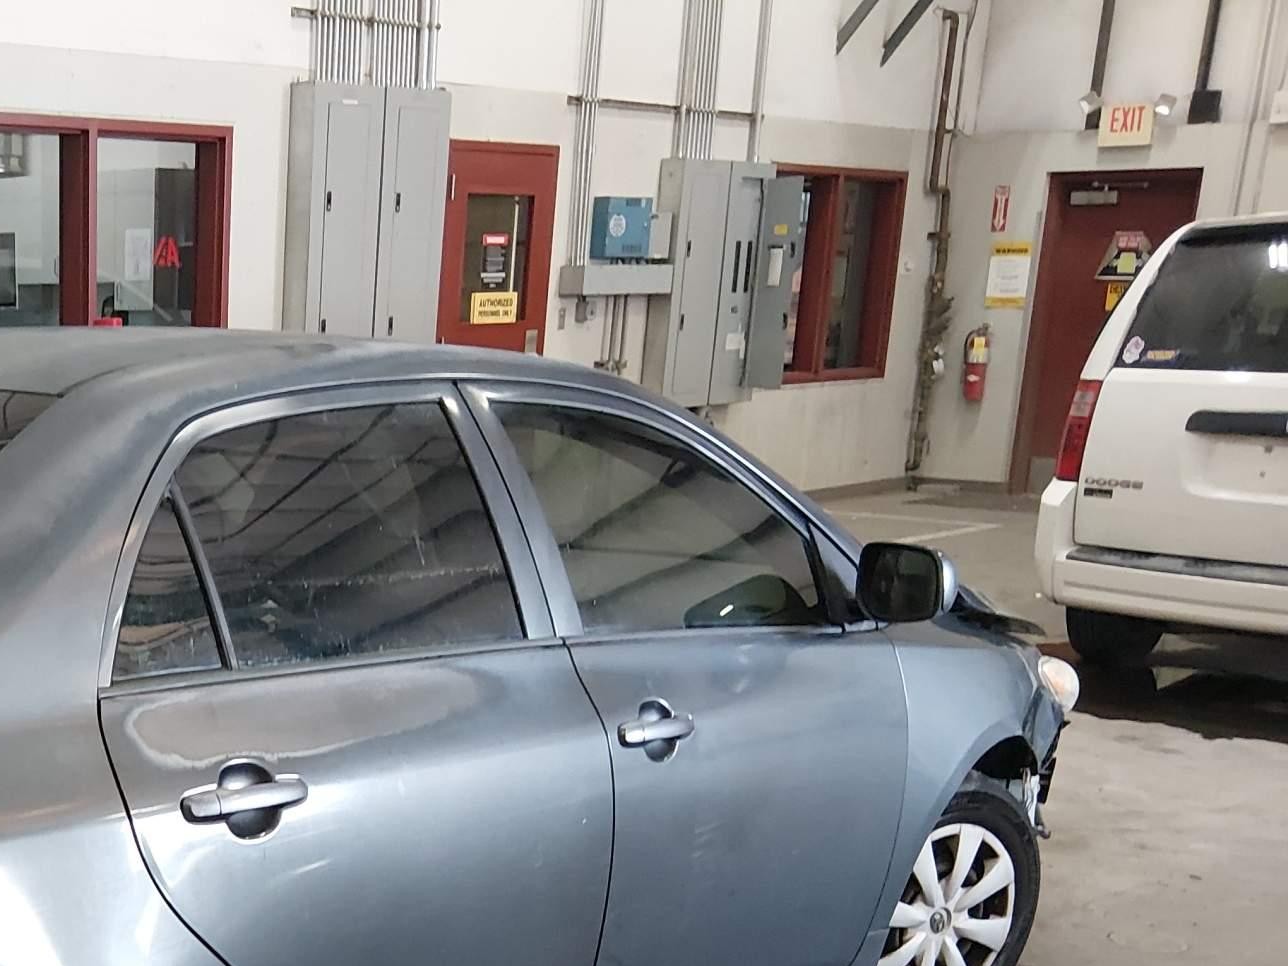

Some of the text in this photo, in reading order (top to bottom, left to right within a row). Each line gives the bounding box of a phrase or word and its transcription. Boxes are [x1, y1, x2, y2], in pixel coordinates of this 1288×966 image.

[1110, 105, 1146, 133] EXIT
[479, 298, 514, 308] AUTHORIZED
[1084, 477, 1144, 490] DODGE
